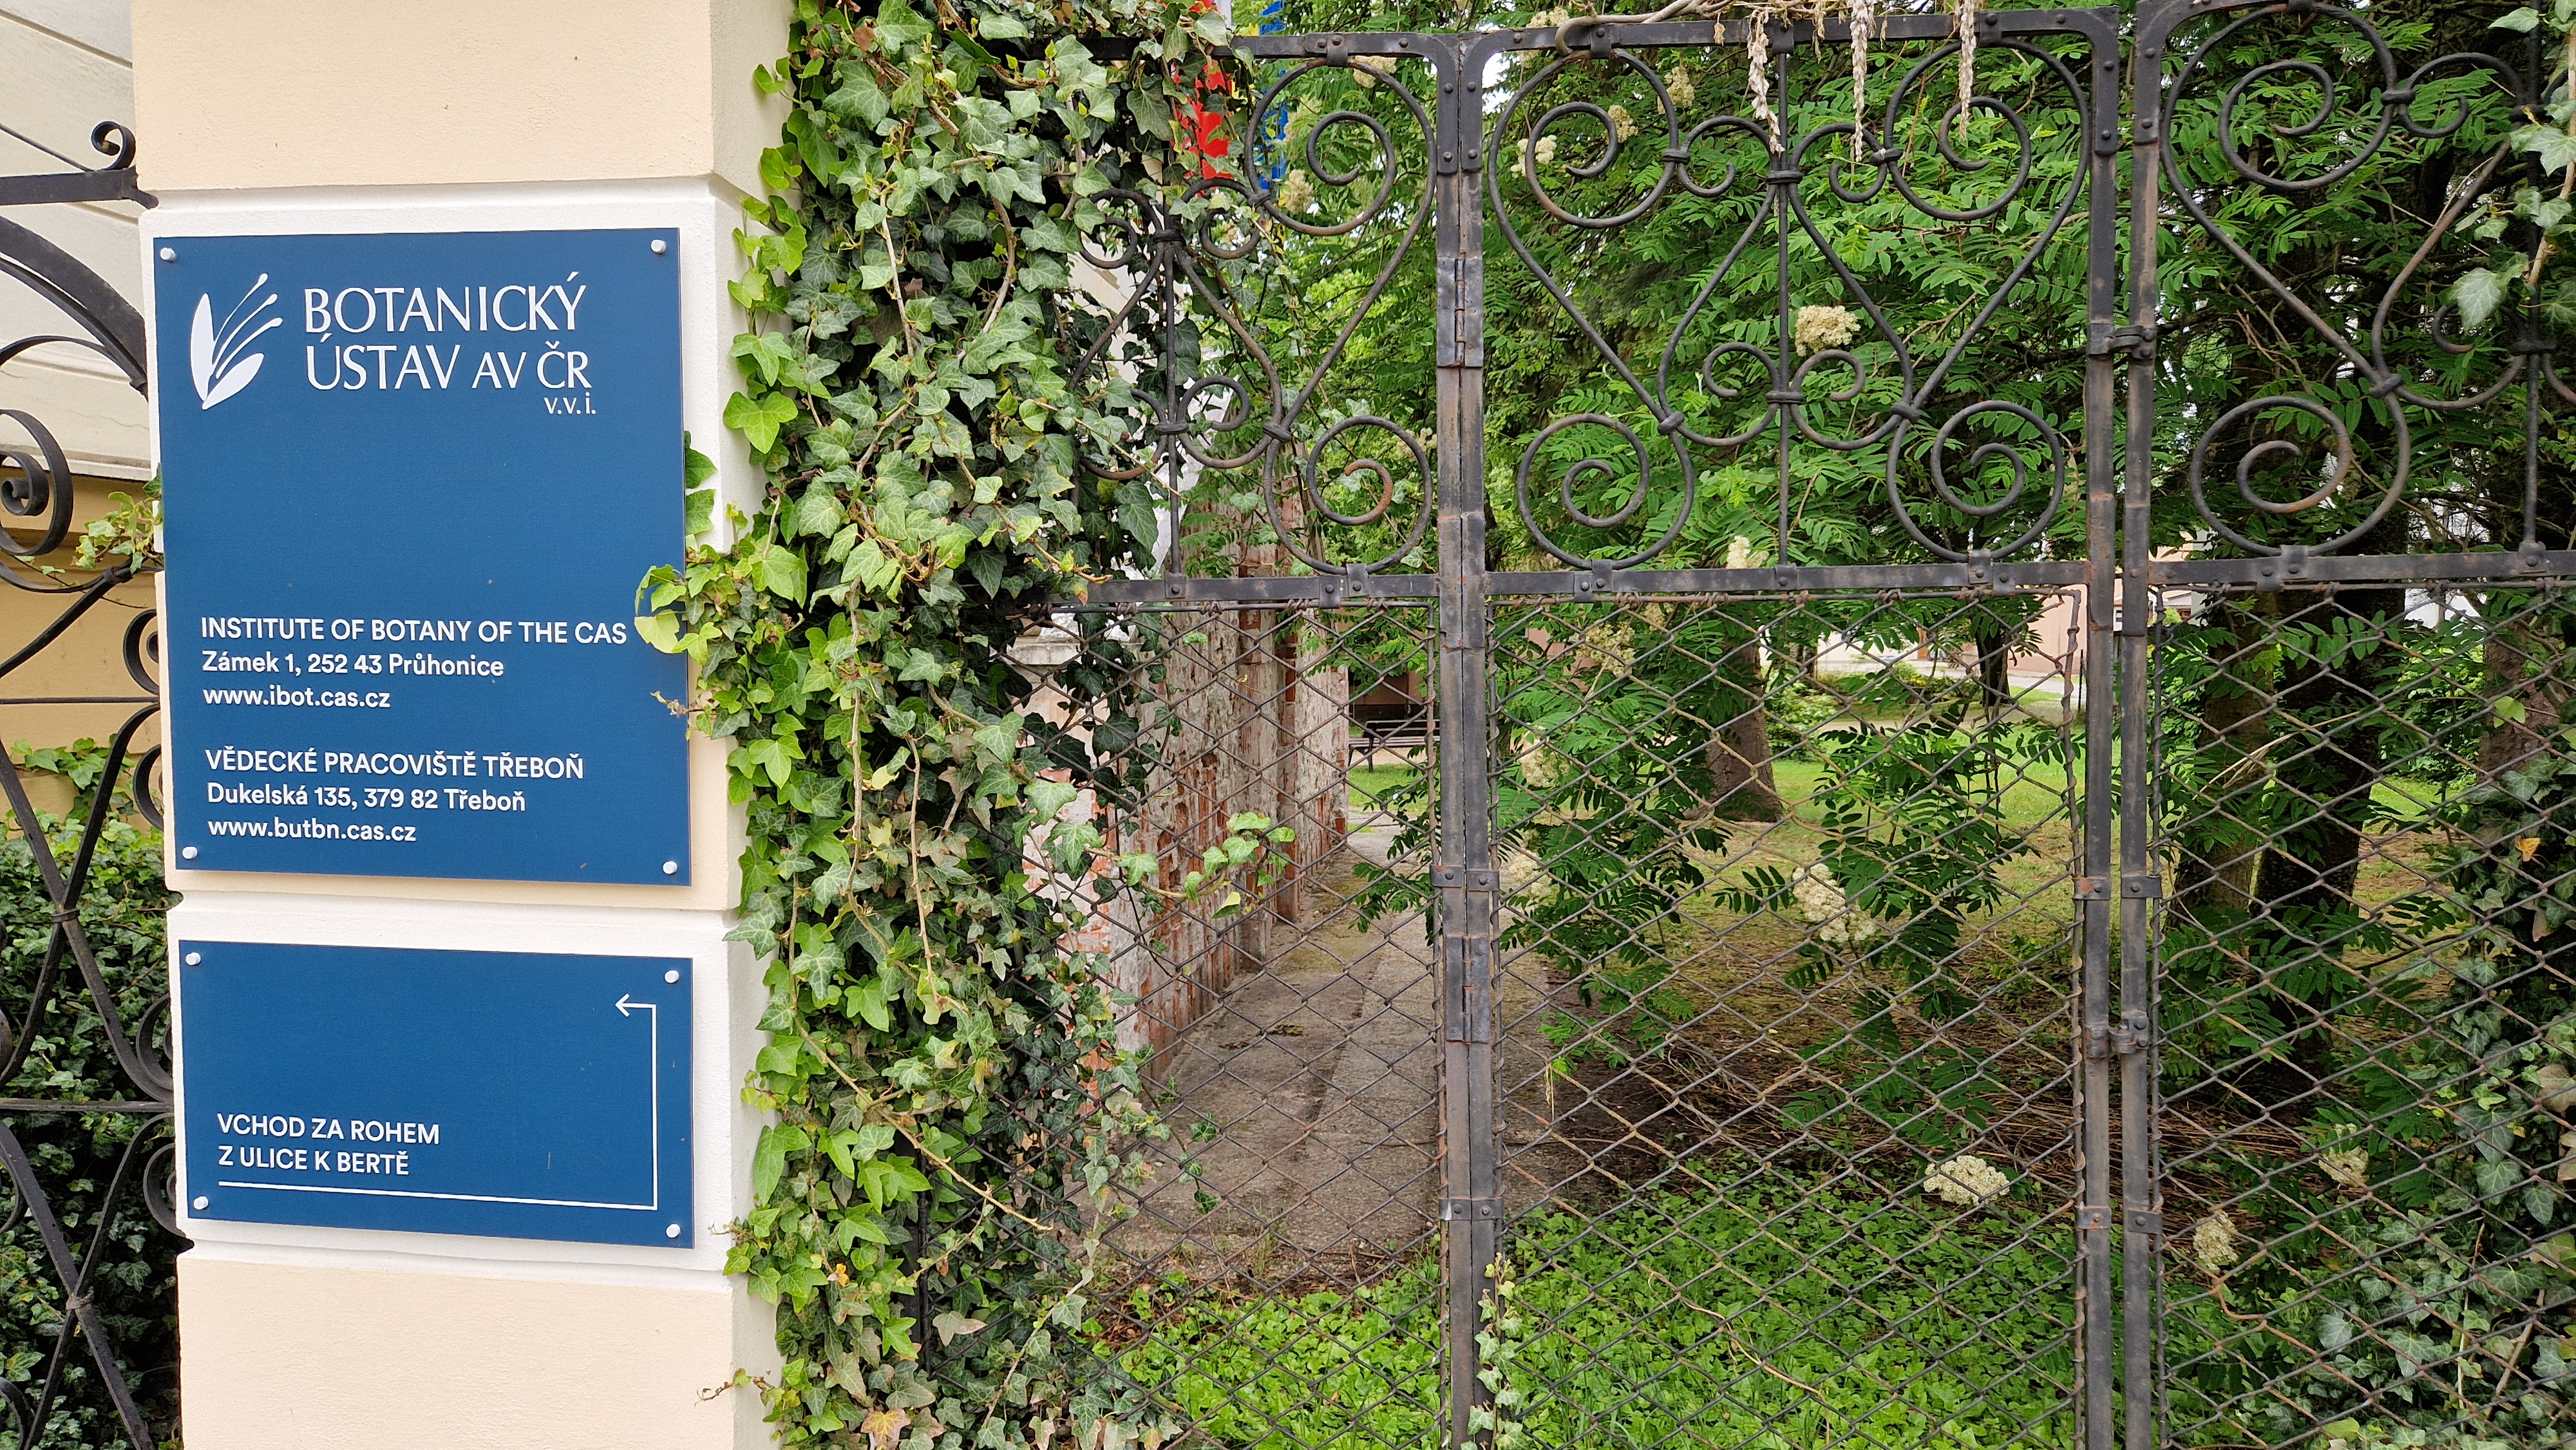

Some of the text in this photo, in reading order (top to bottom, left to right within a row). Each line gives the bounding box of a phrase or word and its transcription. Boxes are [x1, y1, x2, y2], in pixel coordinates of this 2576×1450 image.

[304, 271, 587, 333] BOTANICKÝ
[306, 332, 592, 390] ÚSTAV AV ČR
[202, 617, 627, 645] INSTITUTE OF BOTANY OF THE CAS
[202, 650, 504, 677] Zámek 1, 252 43 Průhonice
[203, 684, 391, 708] www.ibot.cas.cz
[205, 745, 583, 779] VĚDECKÉ PRACOVIŠTĚ TŘEBOŇ
[207, 782, 526, 811] Dukelská 135, 379 82 Třeboň
[207, 816, 416, 842] www.butbn.cas.cz
[216, 1113, 439, 1145] VCHOD ZA ROHEM
[218, 1145, 409, 1175] Z ULICE K BERTĚ
